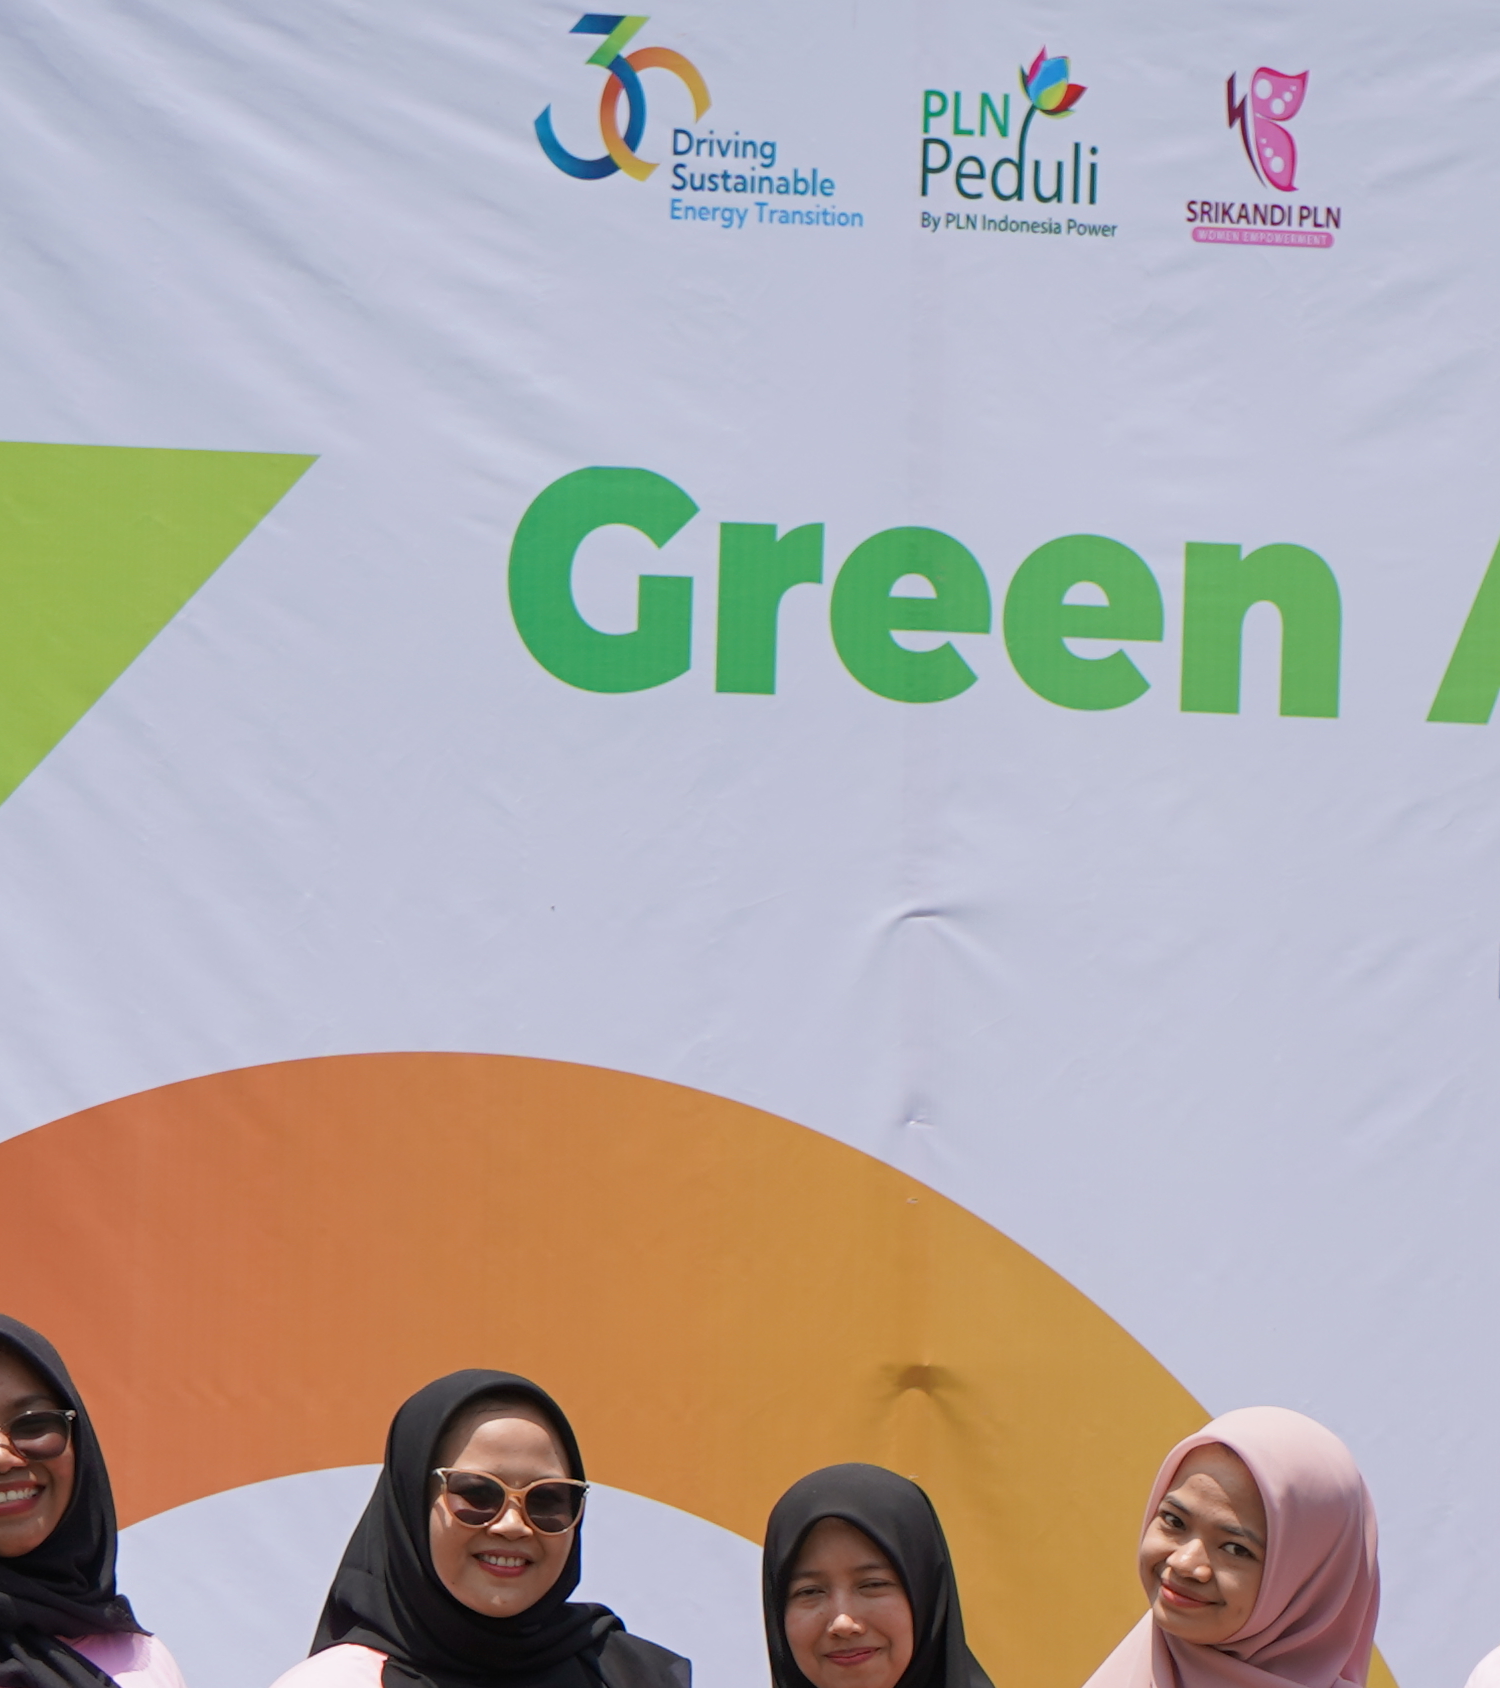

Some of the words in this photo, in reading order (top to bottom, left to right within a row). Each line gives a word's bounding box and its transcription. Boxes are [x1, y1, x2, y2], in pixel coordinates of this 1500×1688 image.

[922, 90, 1010, 138] PLN
[672, 129, 777, 168] Driving
[671, 163, 835, 198] Sustainable
[920, 137, 1099, 206] Peduli
[670, 197, 749, 230] Energy
[754, 201, 864, 228] Transition
[921, 210, 942, 233] By
[945, 212, 978, 231] PLN
[981, 214, 1063, 235] Indonesia
[1066, 218, 1118, 238] Power
[1186, 200, 1293, 227] SRIKANDI
[1298, 205, 1342, 229] PLN
[1198, 229, 1240, 242] WOMEN
[506, 465, 1343, 720] Green
